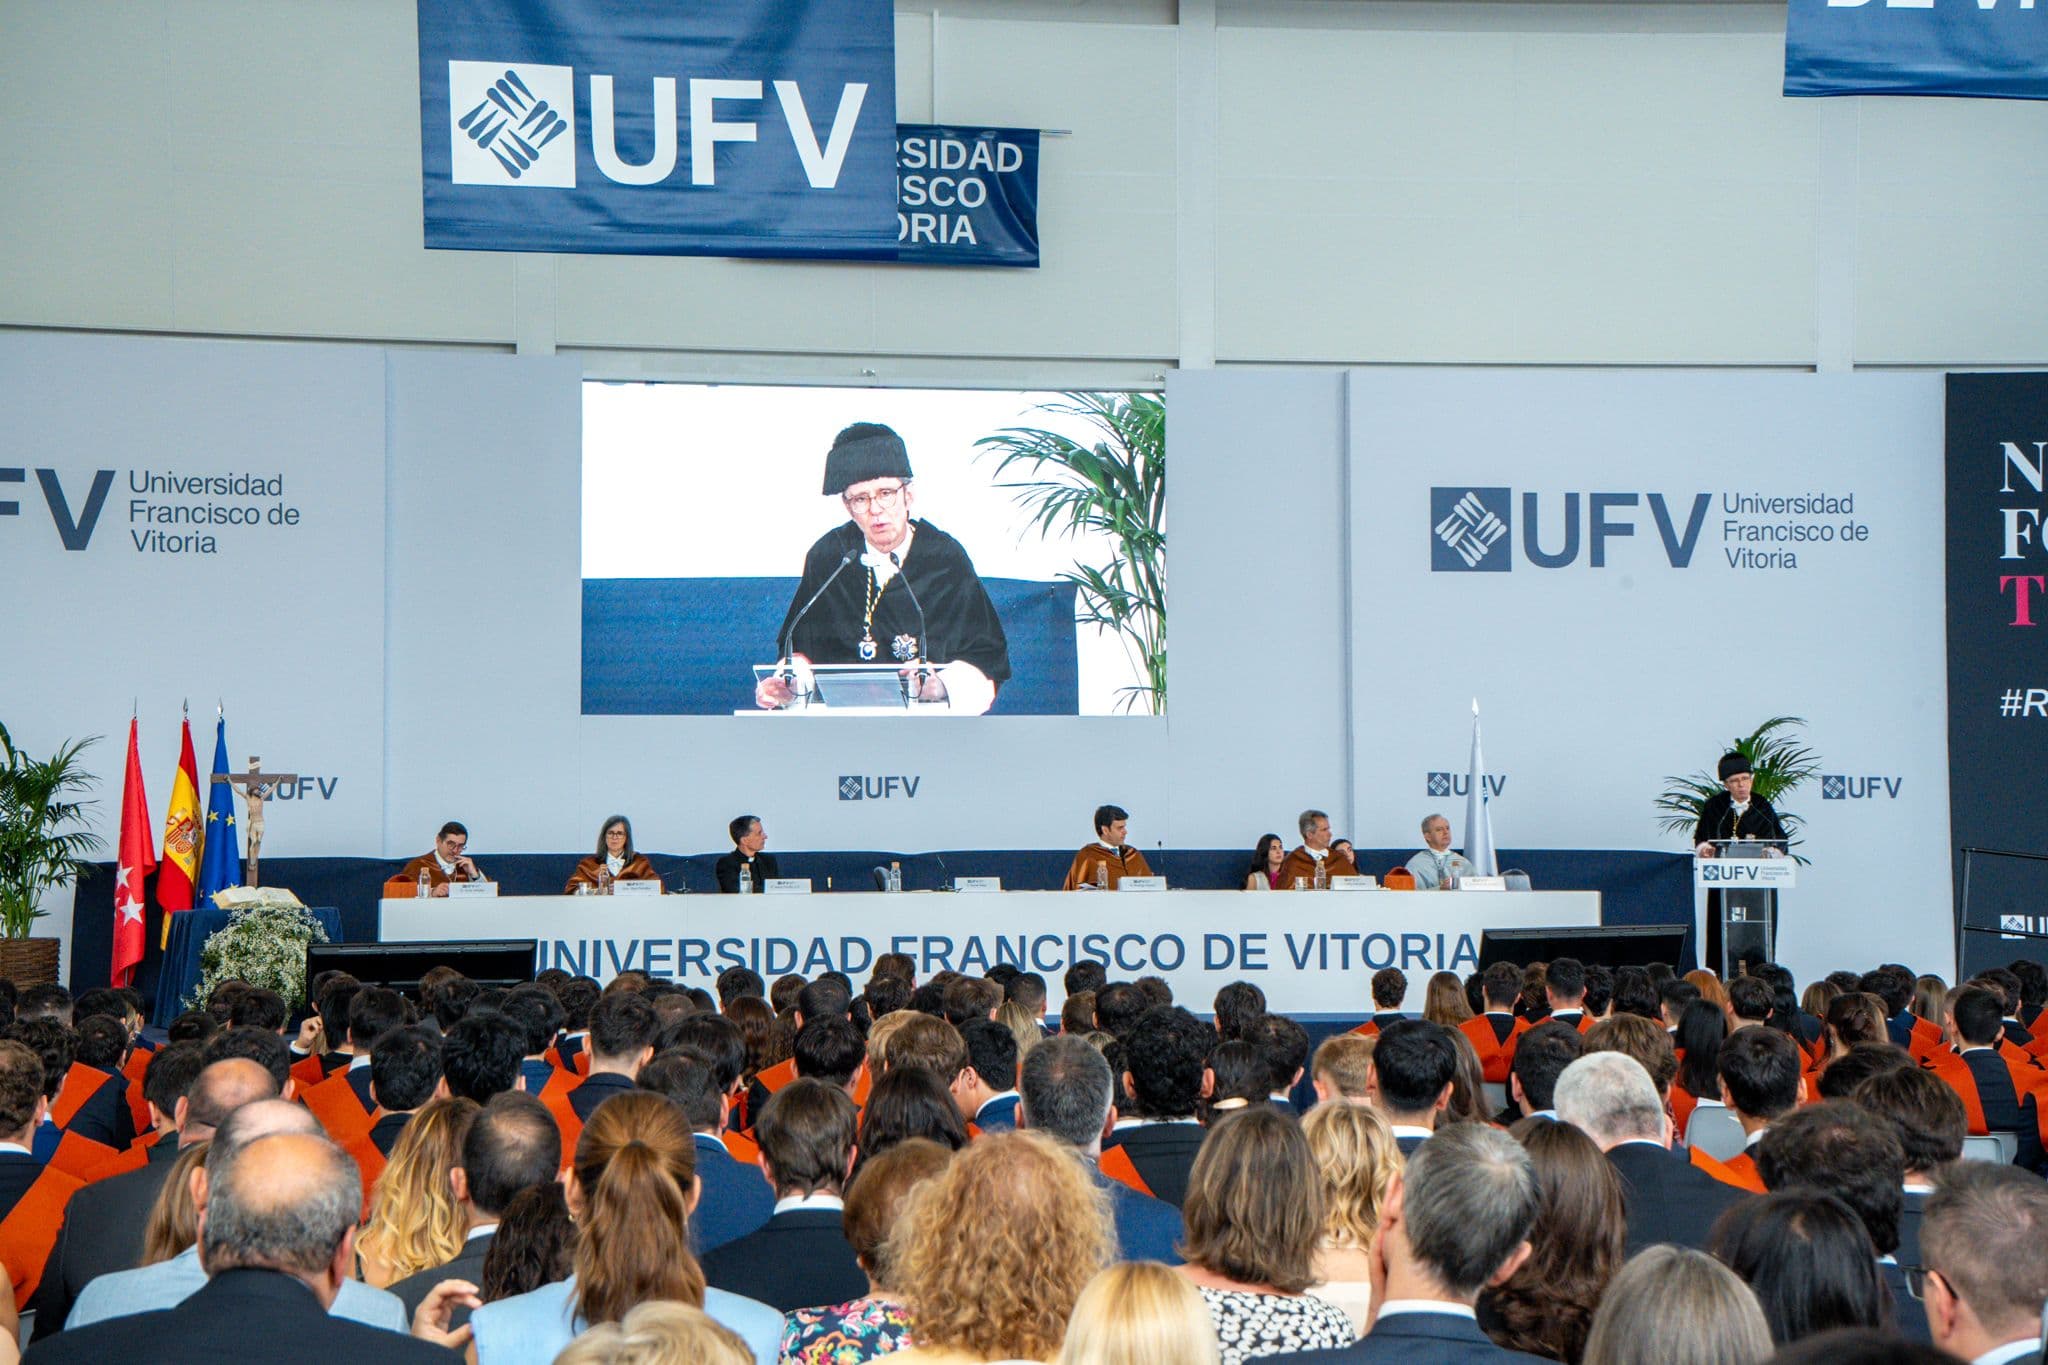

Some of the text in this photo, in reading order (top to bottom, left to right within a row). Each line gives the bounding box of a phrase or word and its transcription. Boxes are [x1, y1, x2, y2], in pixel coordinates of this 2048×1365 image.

[590, 75, 869, 188] UFV
[129, 470, 283, 496] Universidad
[129, 500, 300, 525] Francisco de
[1723, 492, 1853, 514] Universidad
[131, 529, 217, 553] Vitoria
[1522, 492, 1712, 568] UFV
[1724, 520, 1869, 542] Francisco de
[2000, 508, 2048, 559] F
[1725, 547, 1797, 569] Vitoria
[865, 776, 920, 799] UFV
[1453, 774, 1506, 797] UV
[1848, 777, 1902, 799] UFV
[1721, 866, 1758, 880] UFV
[1203, 934, 1268, 970] DE
[1284, 933, 1478, 971] VITORIA
